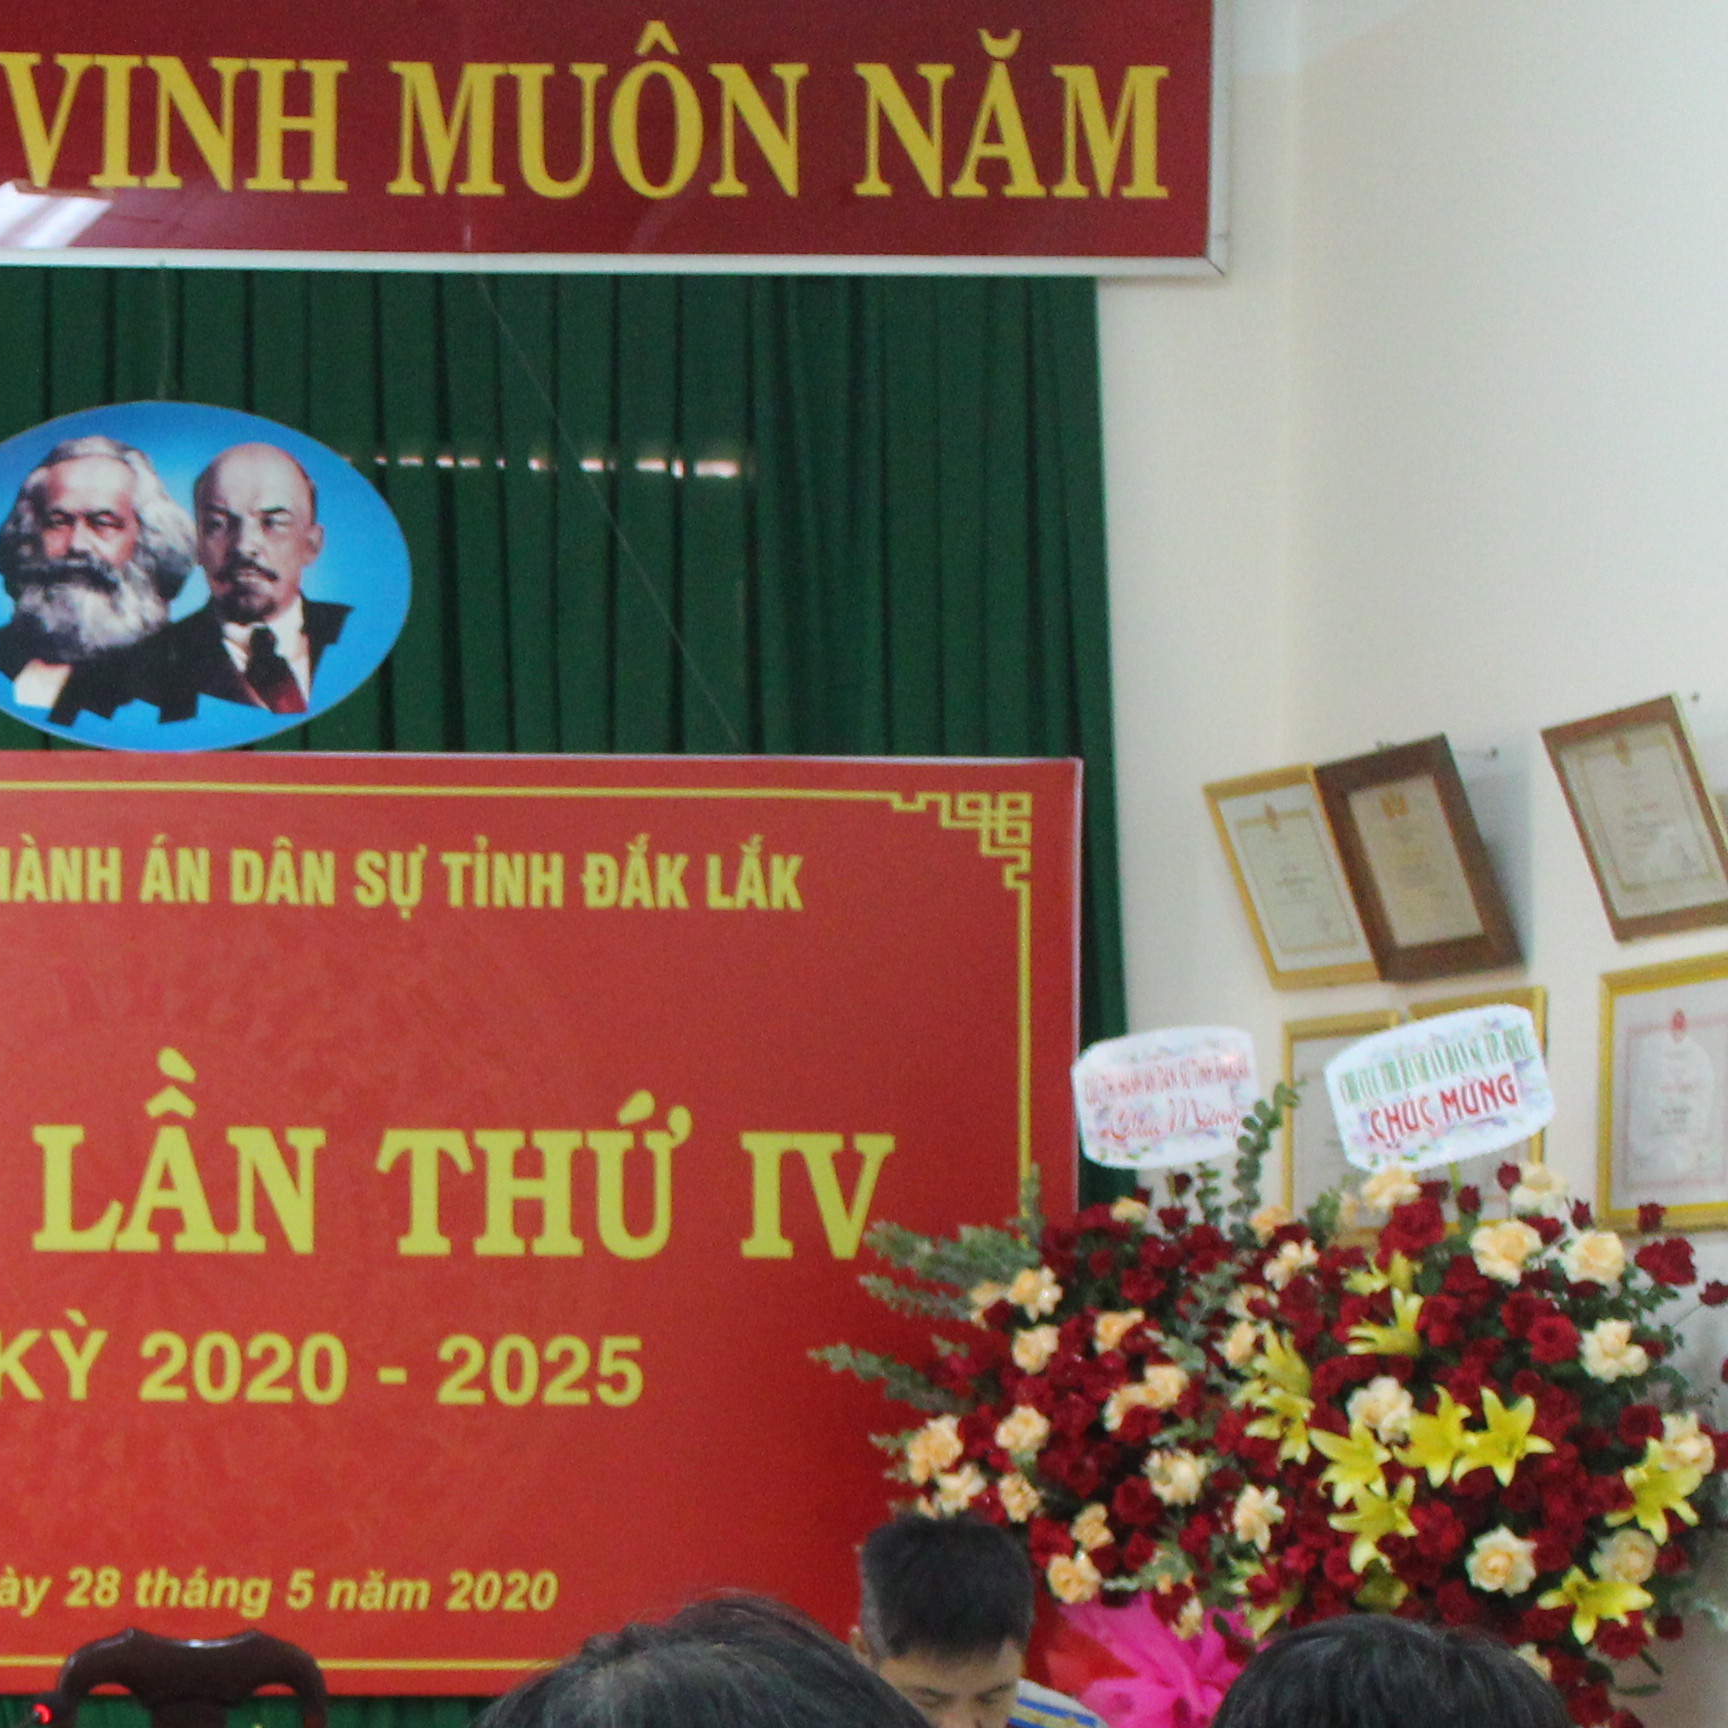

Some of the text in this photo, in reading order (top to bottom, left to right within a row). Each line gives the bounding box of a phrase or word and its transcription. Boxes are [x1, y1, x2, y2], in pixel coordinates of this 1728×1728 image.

[389, 22, 807, 198] MUÔN
[856, 31, 1168, 198] NĂM
[140, 833, 211, 903] ÁN
[230, 836, 335, 906] DÂN
[354, 844, 427, 919] SỰ
[440, 833, 564, 908] TỈNH
[581, 833, 688, 909] ĐẮK
[707, 833, 802, 910] LẮK
[32, 1047, 326, 1256] LẦN
[376, 1090, 692, 1260] THỨ
[740, 1131, 896, 1260] IV
[139, 1330, 347, 1405] 2020
[378, 1368, 407, 1384] -
[437, 1334, 643, 1406] 2025
[64, 1565, 122, 1608] 28
[135, 1567, 273, 1621] tháng
[286, 1568, 315, 1611] 5
[327, 1568, 431, 1611] năm
[446, 1569, 559, 1611] 2020
